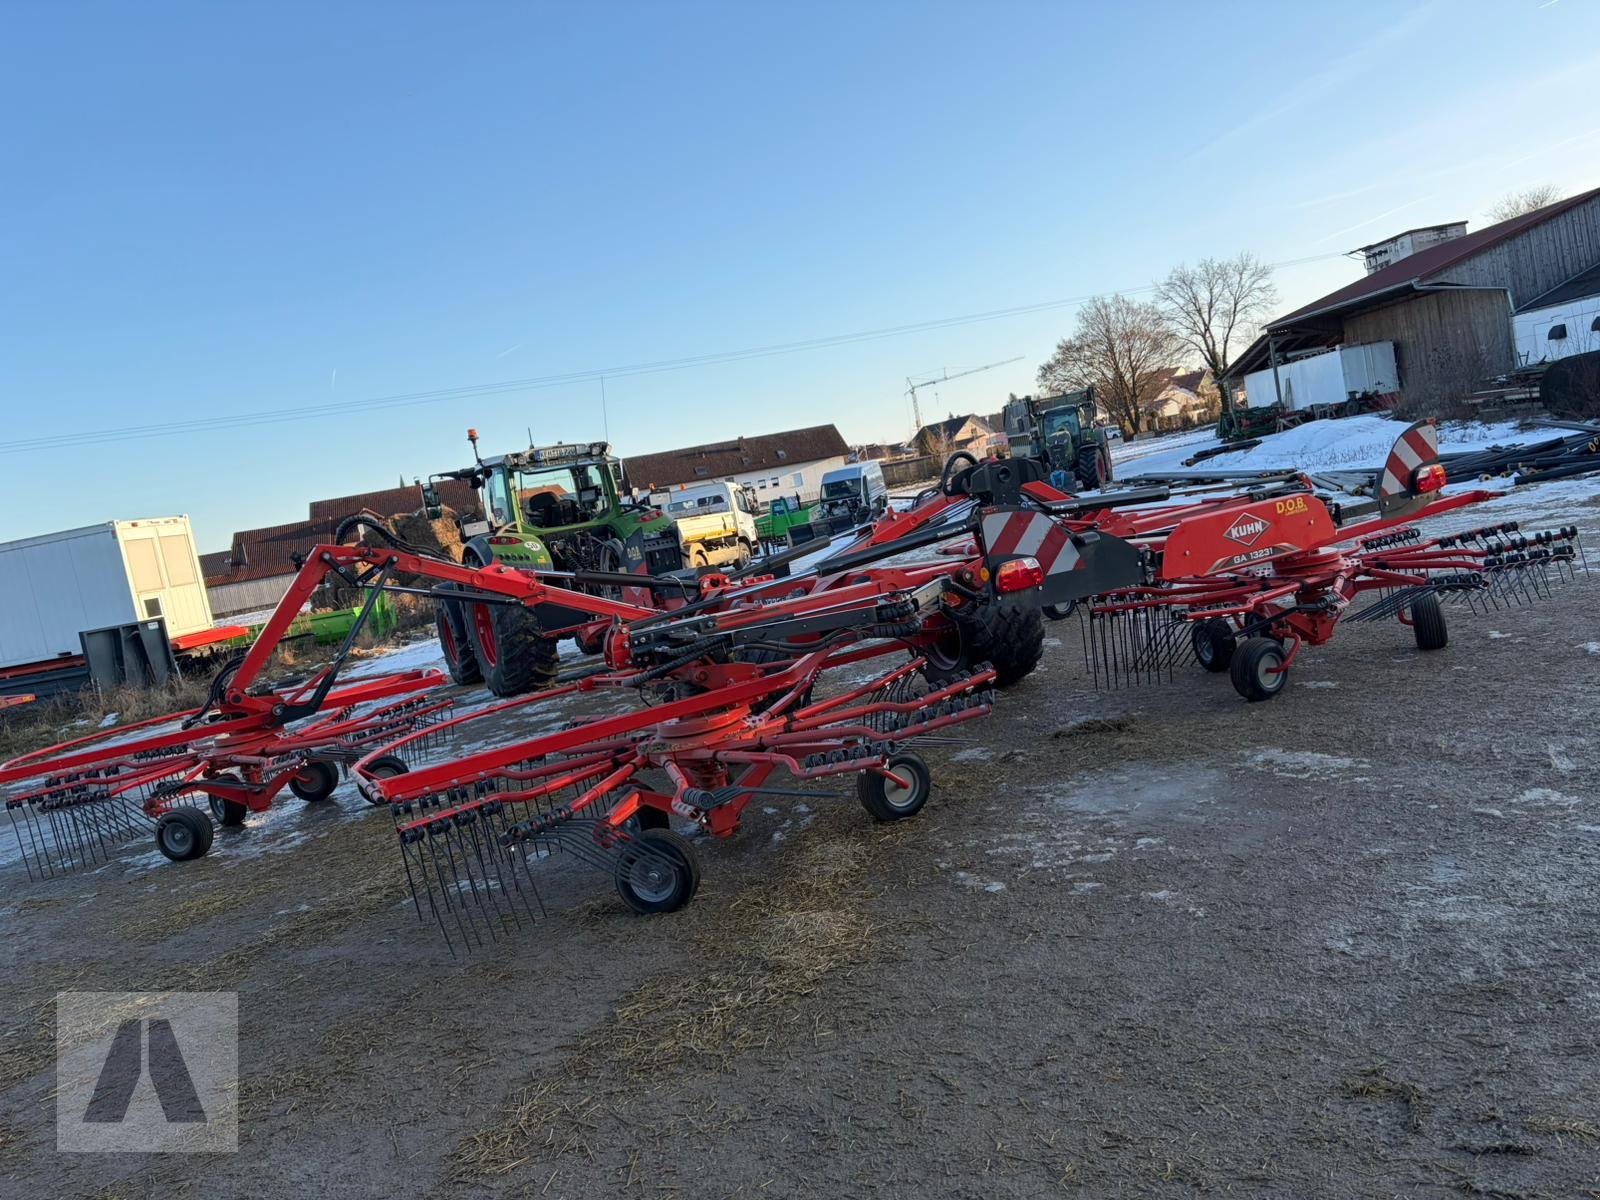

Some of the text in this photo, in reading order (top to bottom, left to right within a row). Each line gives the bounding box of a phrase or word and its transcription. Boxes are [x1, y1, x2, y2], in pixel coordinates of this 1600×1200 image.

[1231, 521, 1263, 539] KUHN
[1233, 547, 1273, 564] GA 13231
